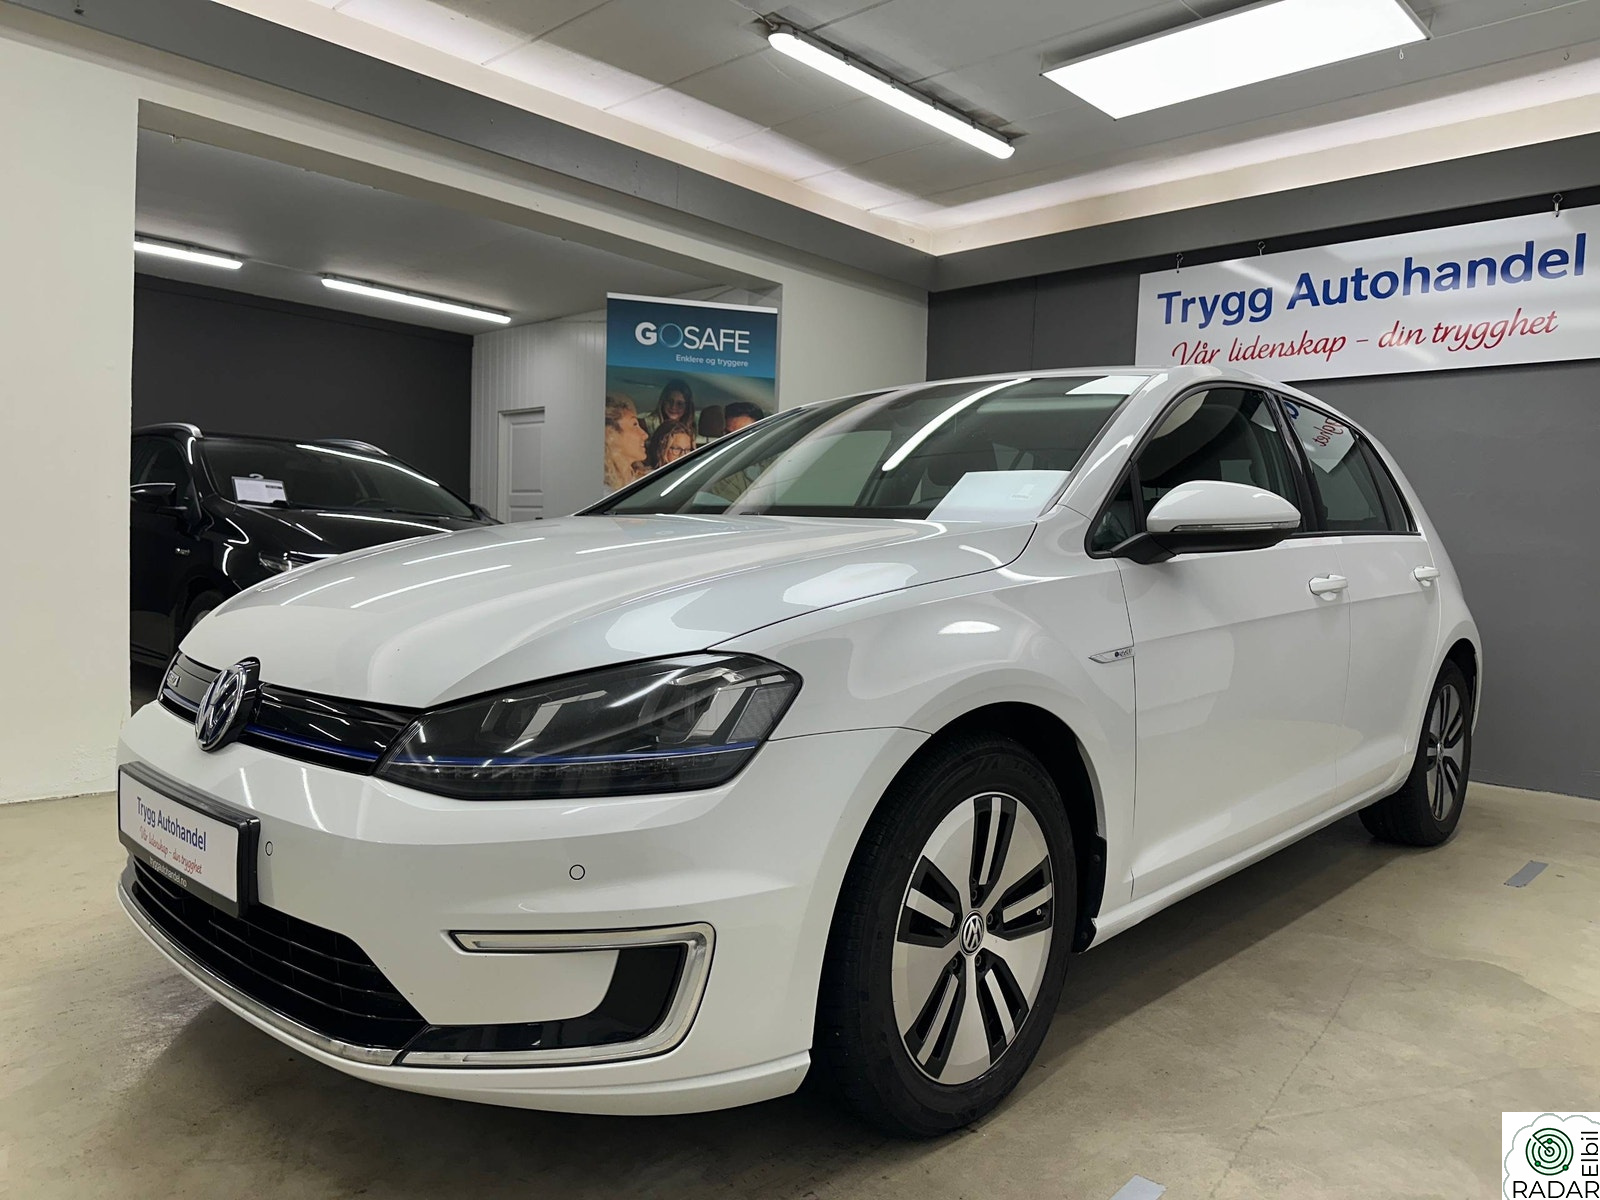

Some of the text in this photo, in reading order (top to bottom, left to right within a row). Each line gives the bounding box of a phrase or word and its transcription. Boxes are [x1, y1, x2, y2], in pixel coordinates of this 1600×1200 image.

[1157, 232, 1587, 329] Trygg Autohandel
[635, 322, 750, 353] GOSAFE
[676, 354, 749, 368] Enklere og tryggere
[1172, 340, 1221, 366] Vår
[1228, 331, 1347, 363] lidenskap
[1378, 320, 1427, 349] din
[1433, 308, 1559, 352] trygghet
[137, 796, 207, 851] Trygg Autohandel
